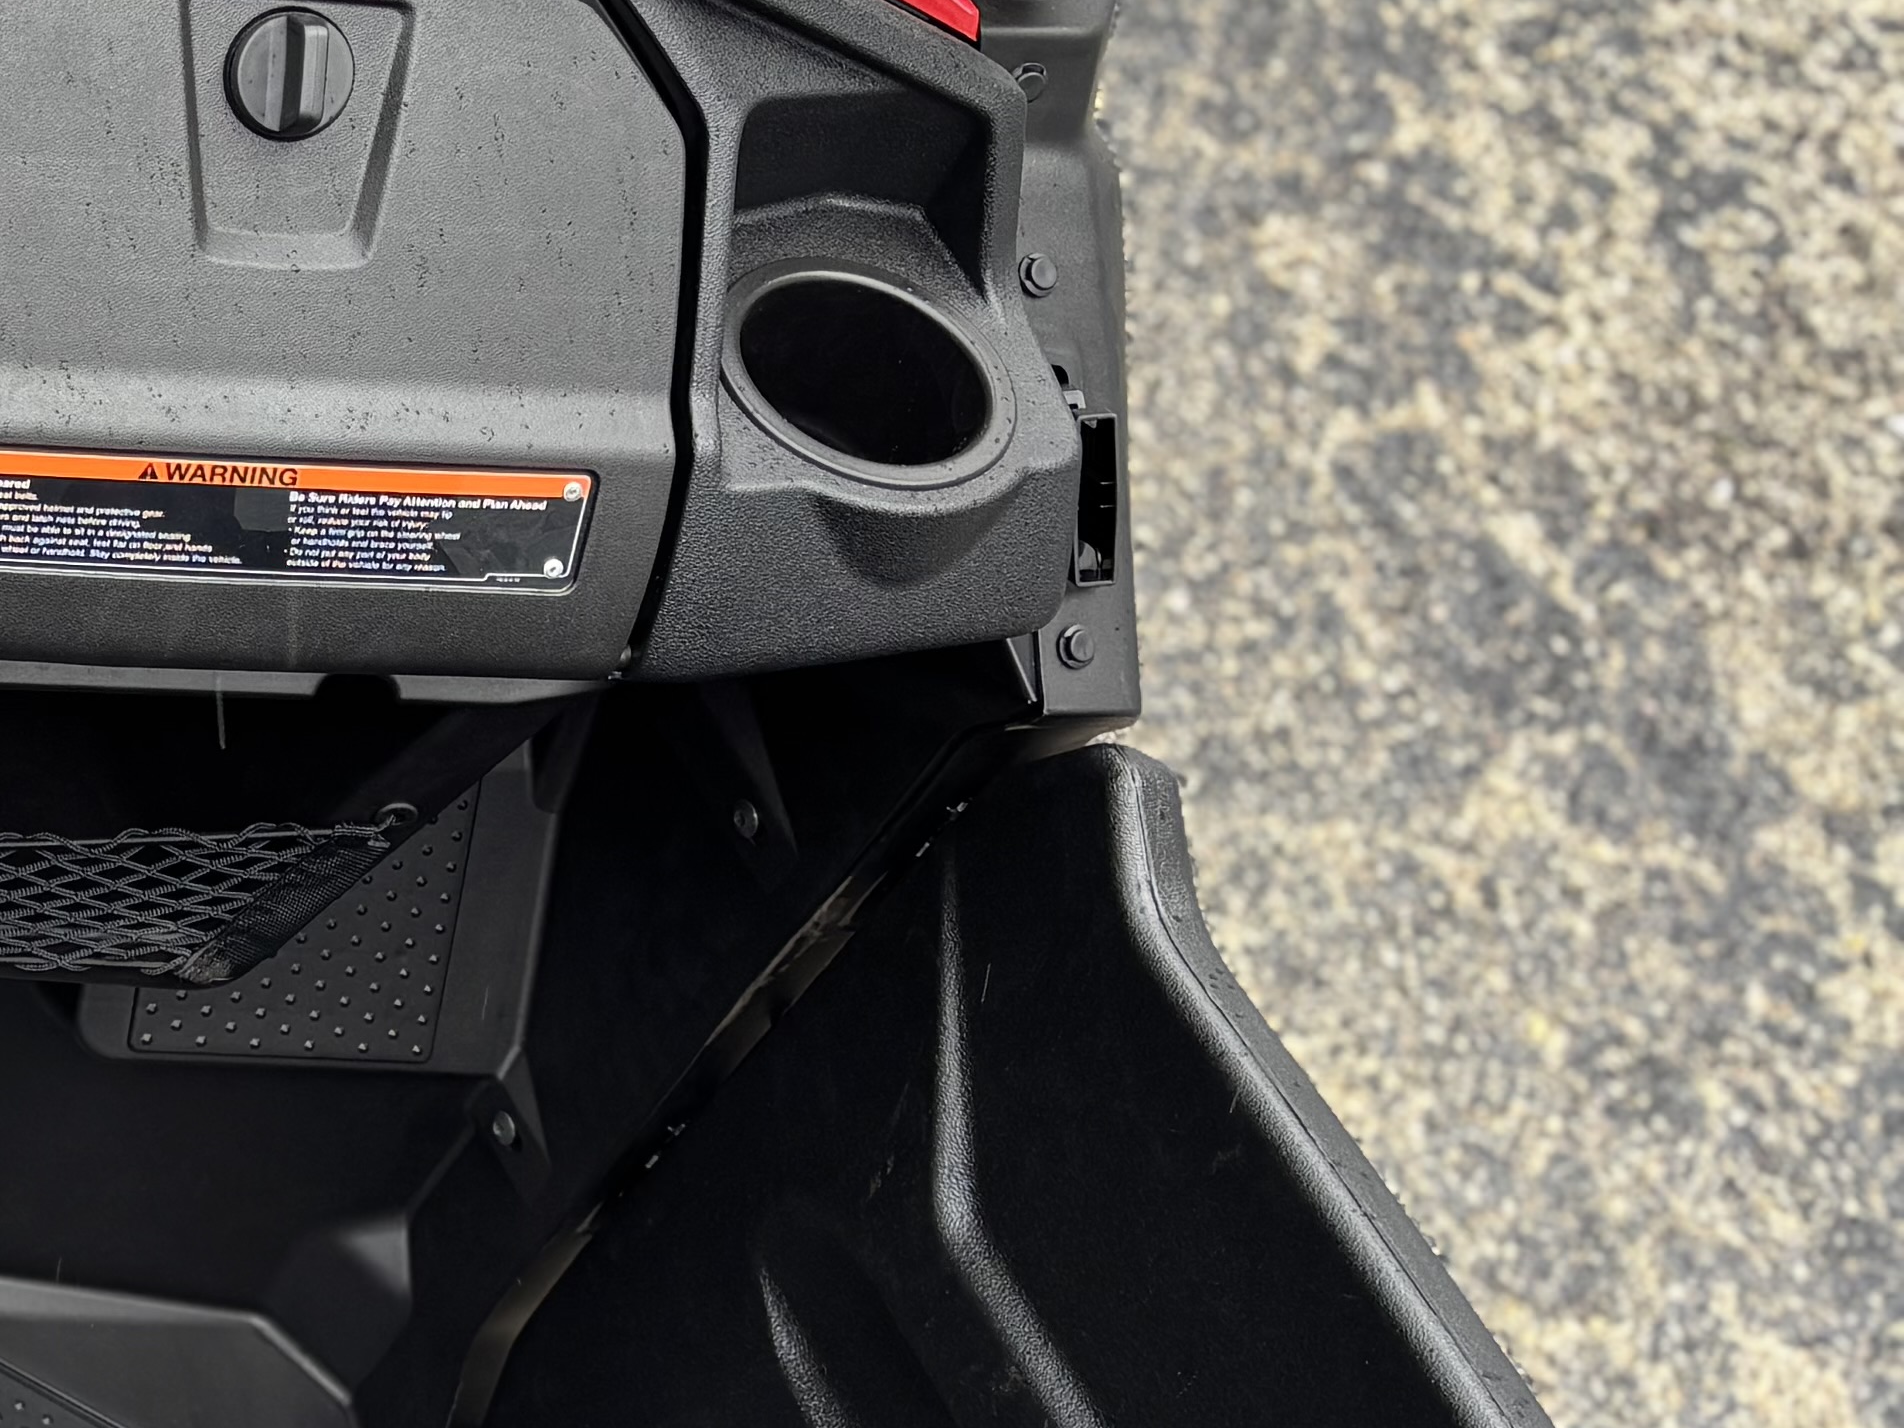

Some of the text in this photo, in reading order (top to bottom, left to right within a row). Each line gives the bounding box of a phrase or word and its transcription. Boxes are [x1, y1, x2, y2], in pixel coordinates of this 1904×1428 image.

[165, 462, 298, 487] WARNING
[307, 491, 336, 504] Sure
[378, 494, 403, 508] Pay
[457, 498, 482, 509] and
